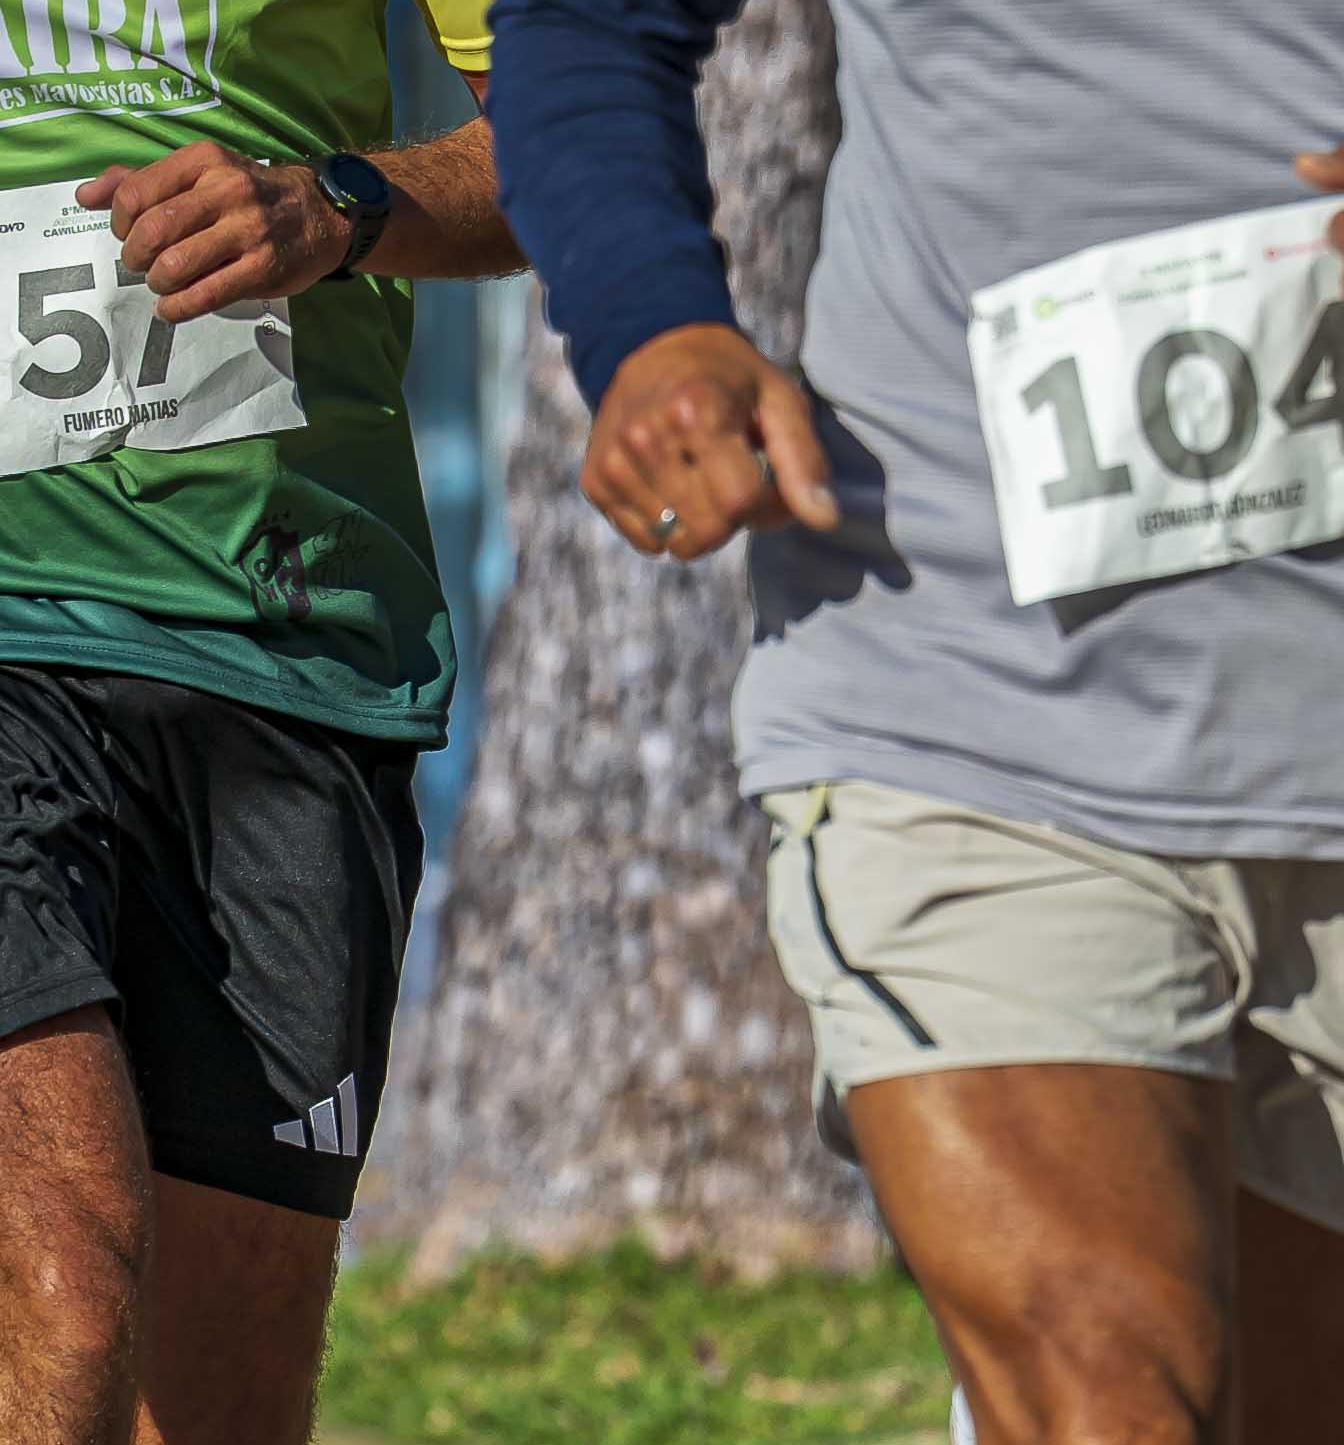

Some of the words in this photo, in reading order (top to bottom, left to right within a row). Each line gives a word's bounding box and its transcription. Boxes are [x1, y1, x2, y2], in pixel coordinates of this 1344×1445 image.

[31, 80, 155, 107] Mayoristas
[159, 75, 202, 102] S.A.
[63, 406, 125, 433] FUMERO
[127, 398, 179, 427] MATIAS
